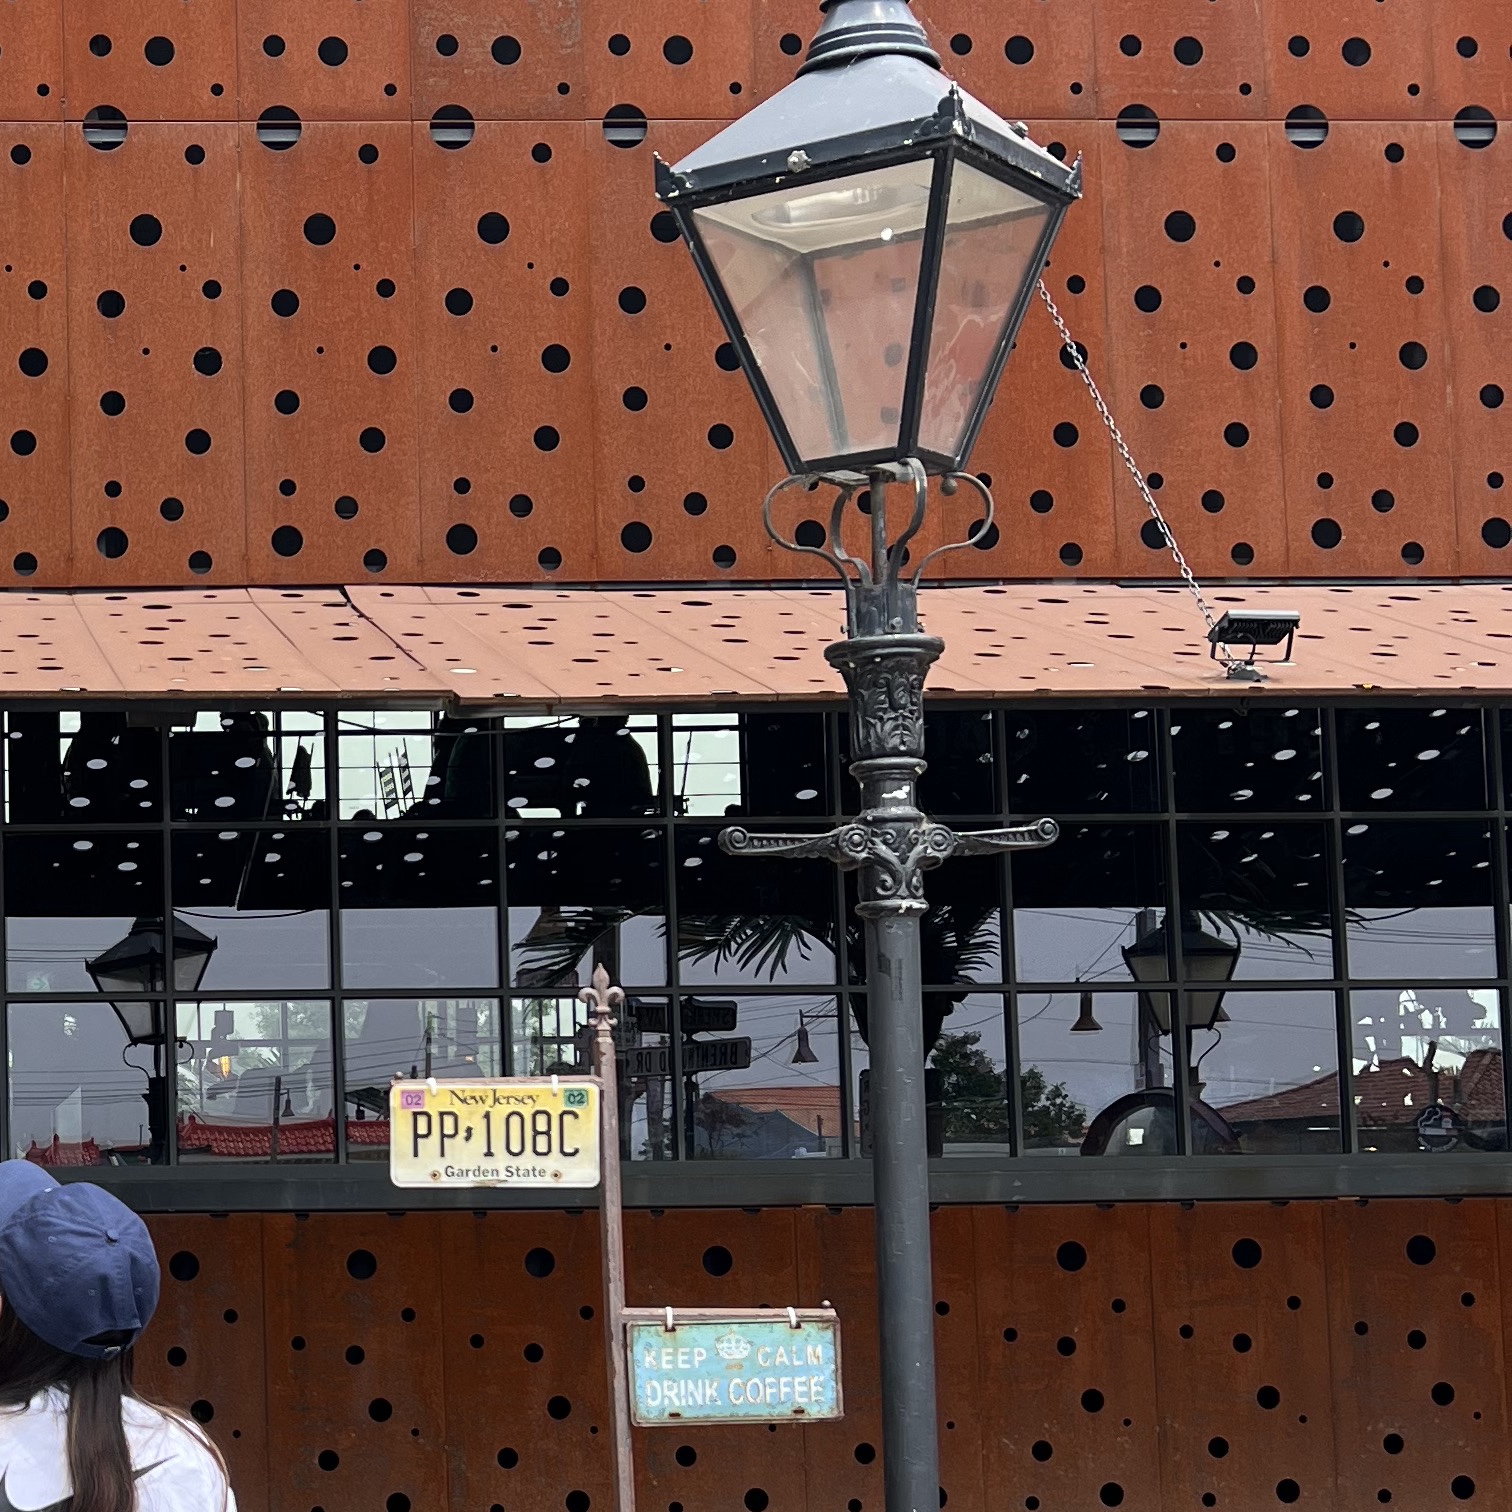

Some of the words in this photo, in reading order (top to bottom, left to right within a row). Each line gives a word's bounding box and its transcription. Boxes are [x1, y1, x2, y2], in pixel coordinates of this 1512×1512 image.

[405, 1094, 422, 1106] 02
[449, 1089, 488, 1106] New
[488, 1088, 540, 1108] Jersey
[567, 1092, 586, 1104] 02
[445, 1165, 499, 1178] Garden
[505, 1165, 547, 1178] State
[644, 1347, 707, 1370] KEEP
[757, 1343, 823, 1367] CALM
[645, 1379, 722, 1407] DRINK
[728, 1375, 826, 1405] COFFEE
